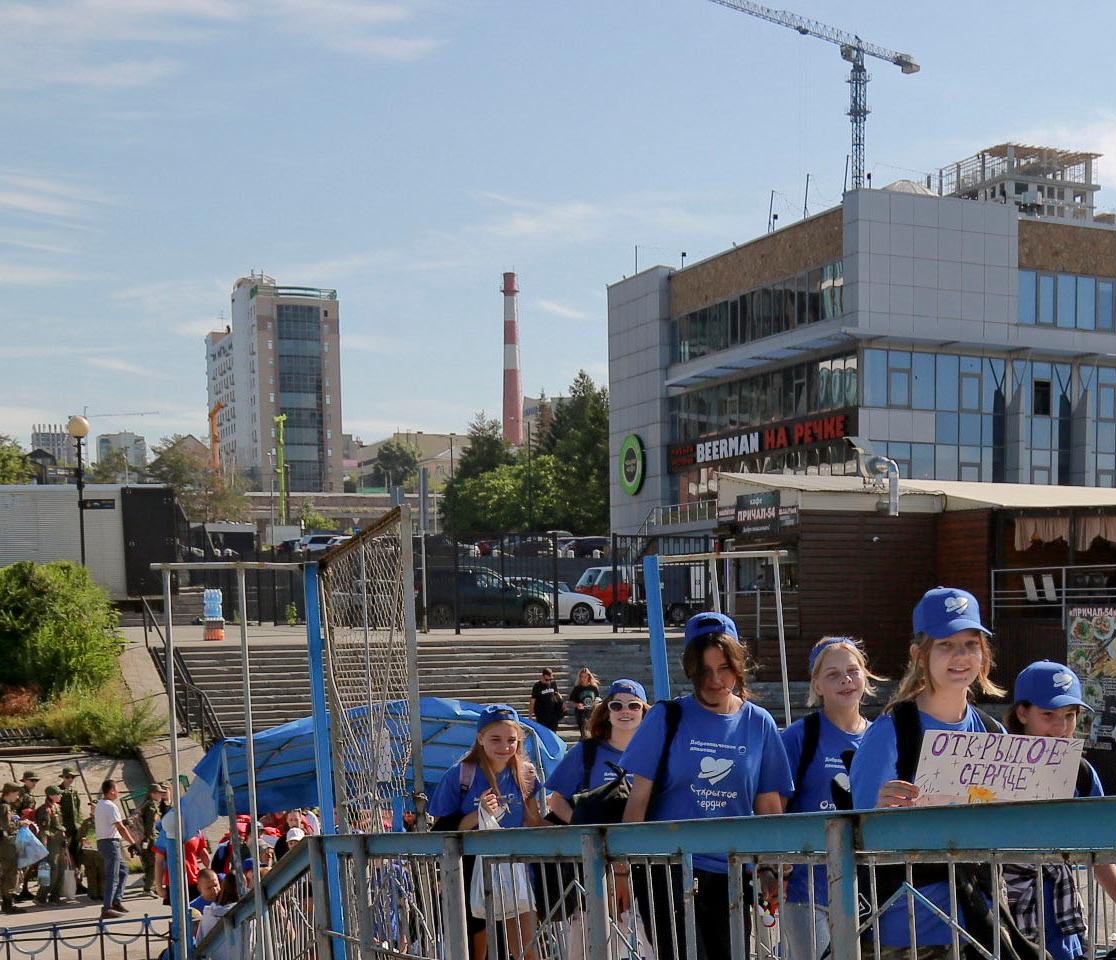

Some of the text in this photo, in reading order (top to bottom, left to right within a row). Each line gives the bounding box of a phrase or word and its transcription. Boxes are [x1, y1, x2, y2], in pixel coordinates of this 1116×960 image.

[696, 415, 845, 463] BEERMAN НА РЕЧКЕ
[737, 506, 776, 522] ПРИЧАЛ-54
[931, 732, 1069, 767] ОТКРЫТОЕ
[697, 800, 727, 811] ердце
